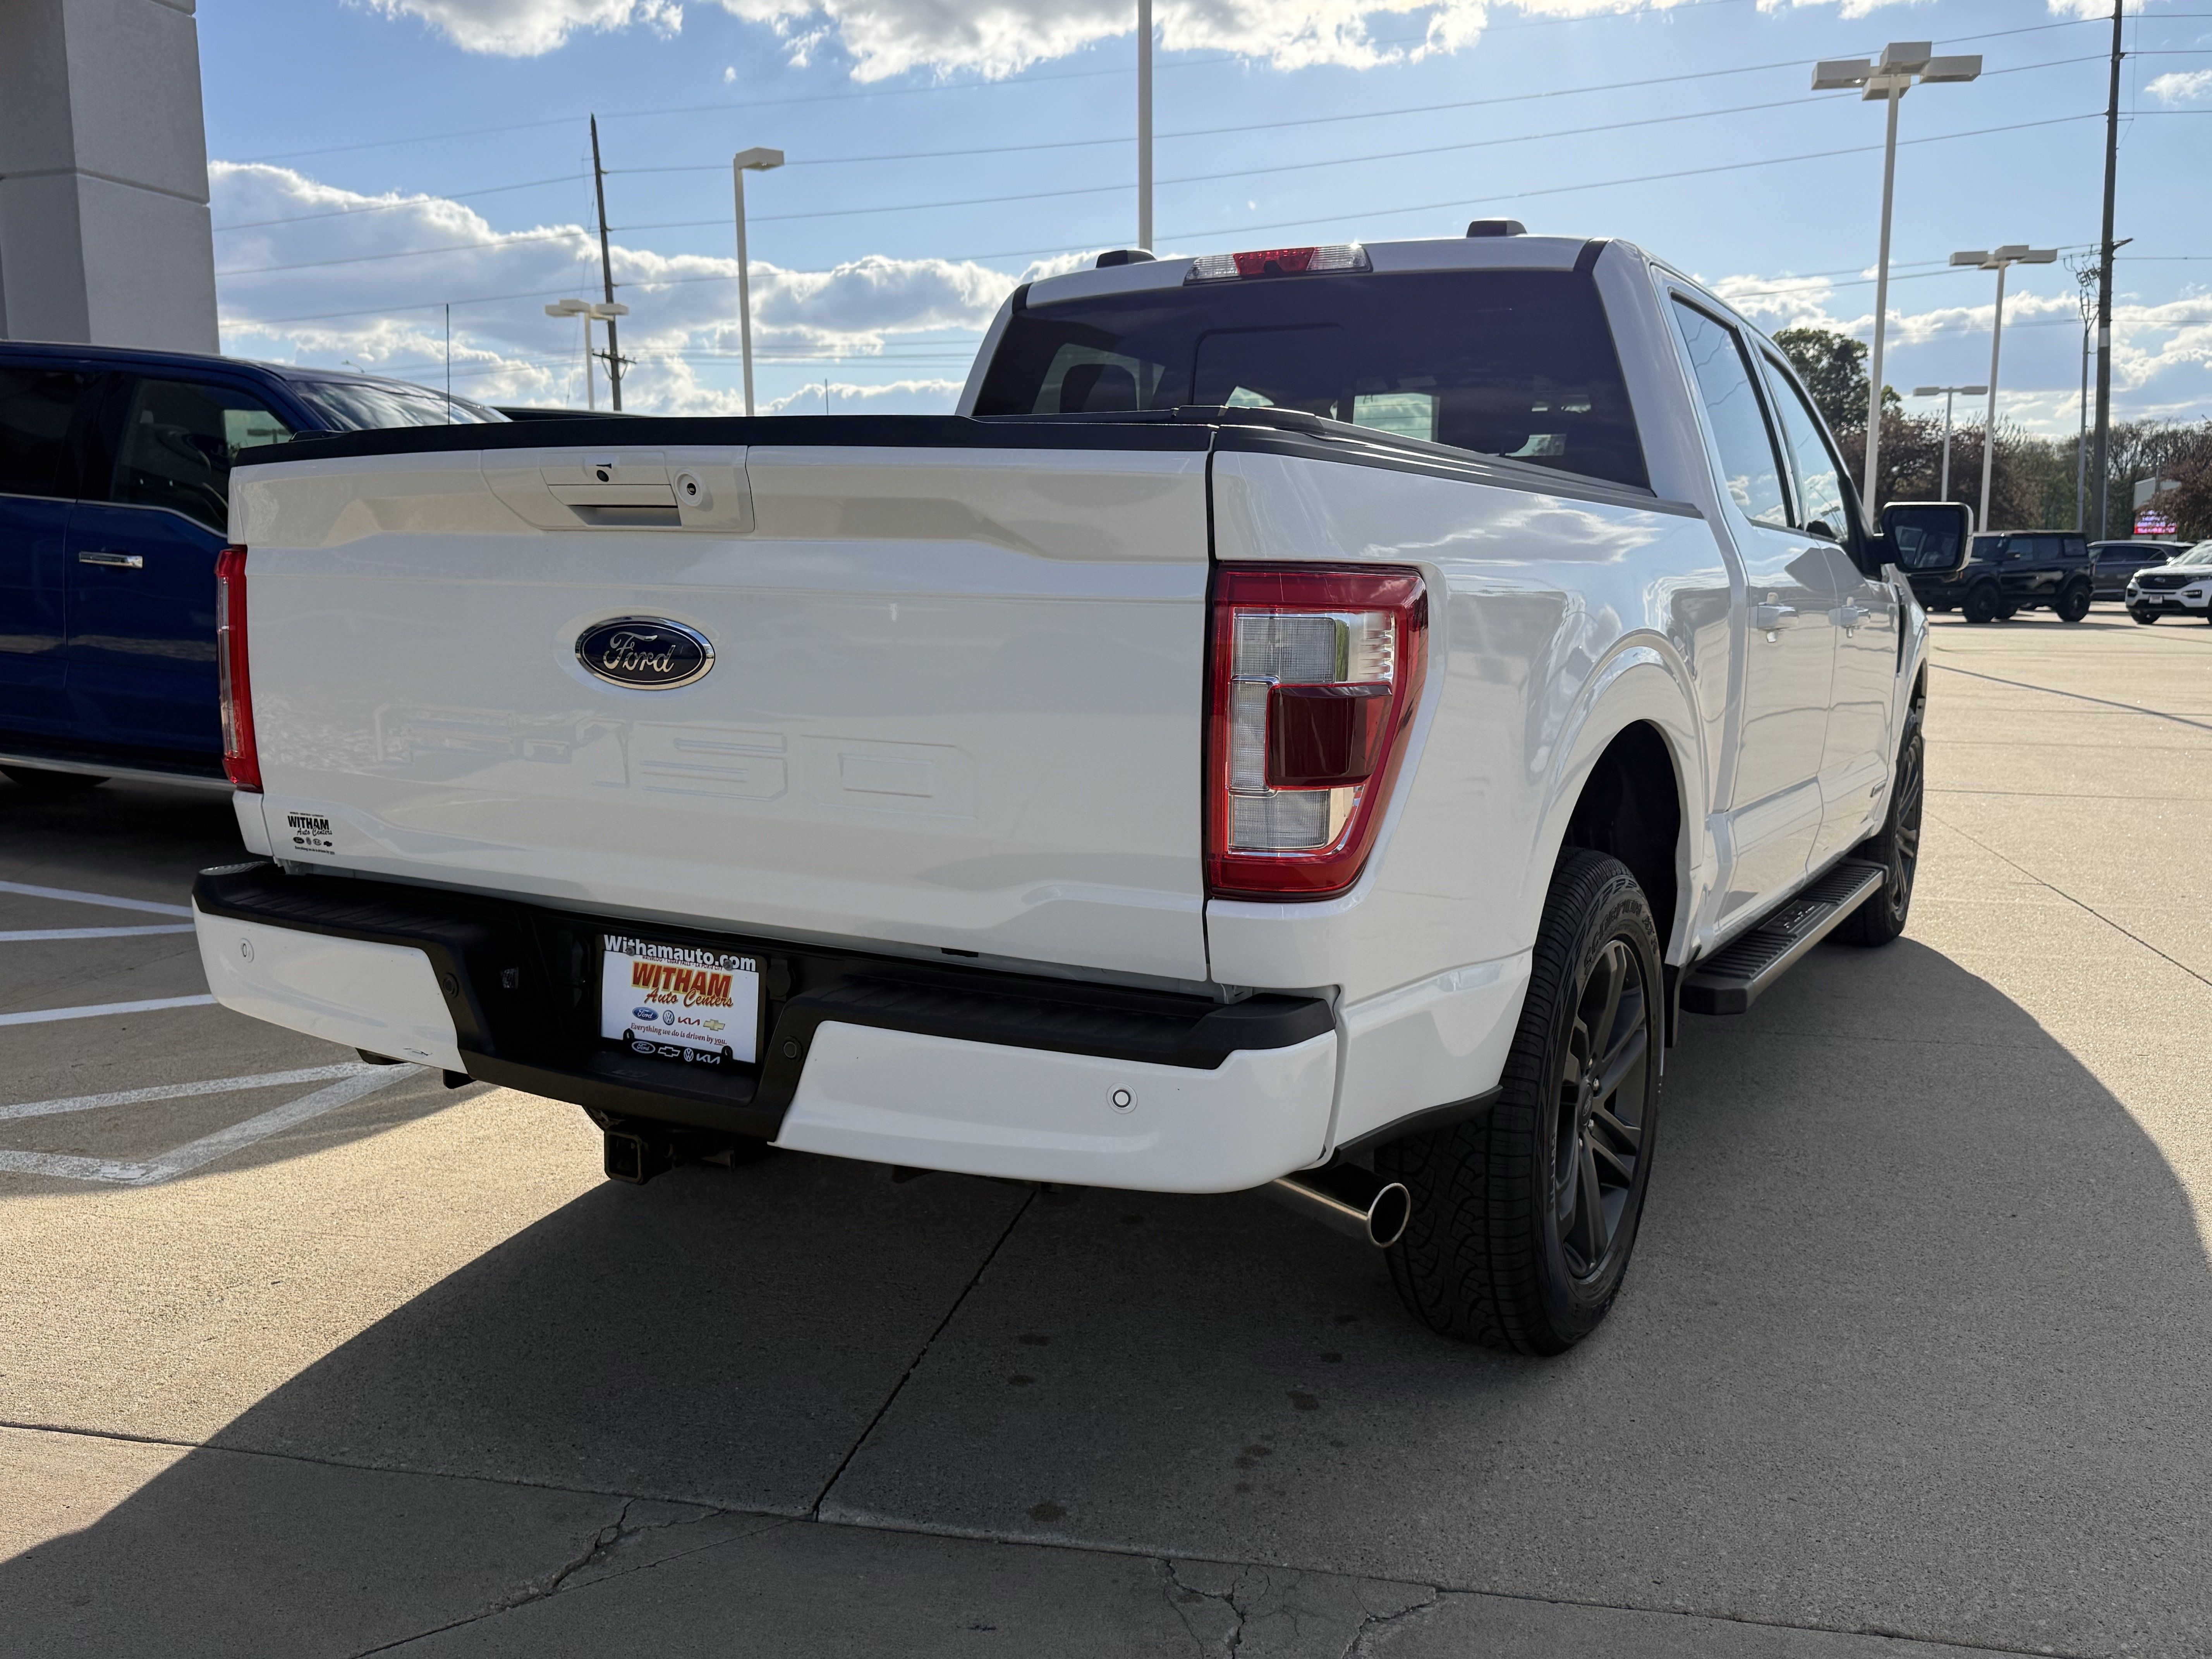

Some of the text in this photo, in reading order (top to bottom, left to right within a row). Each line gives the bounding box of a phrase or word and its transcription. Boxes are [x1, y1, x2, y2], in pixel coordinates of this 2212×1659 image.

[602, 630, 677, 673] Ford
[374, 703, 980, 821] F-150
[287, 815, 330, 830] WITHAM
[312, 827, 332, 836] Centers
[604, 934, 756, 971] Withamauto.com
[632, 961, 733, 999] WITHAM
[644, 987, 734, 1008] Auto Centers
[637, 1008, 654, 1020] Ford
[630, 1022, 661, 1036] Everything
[686, 1032, 705, 1041] driven
[706, 1035, 714, 1044] by
